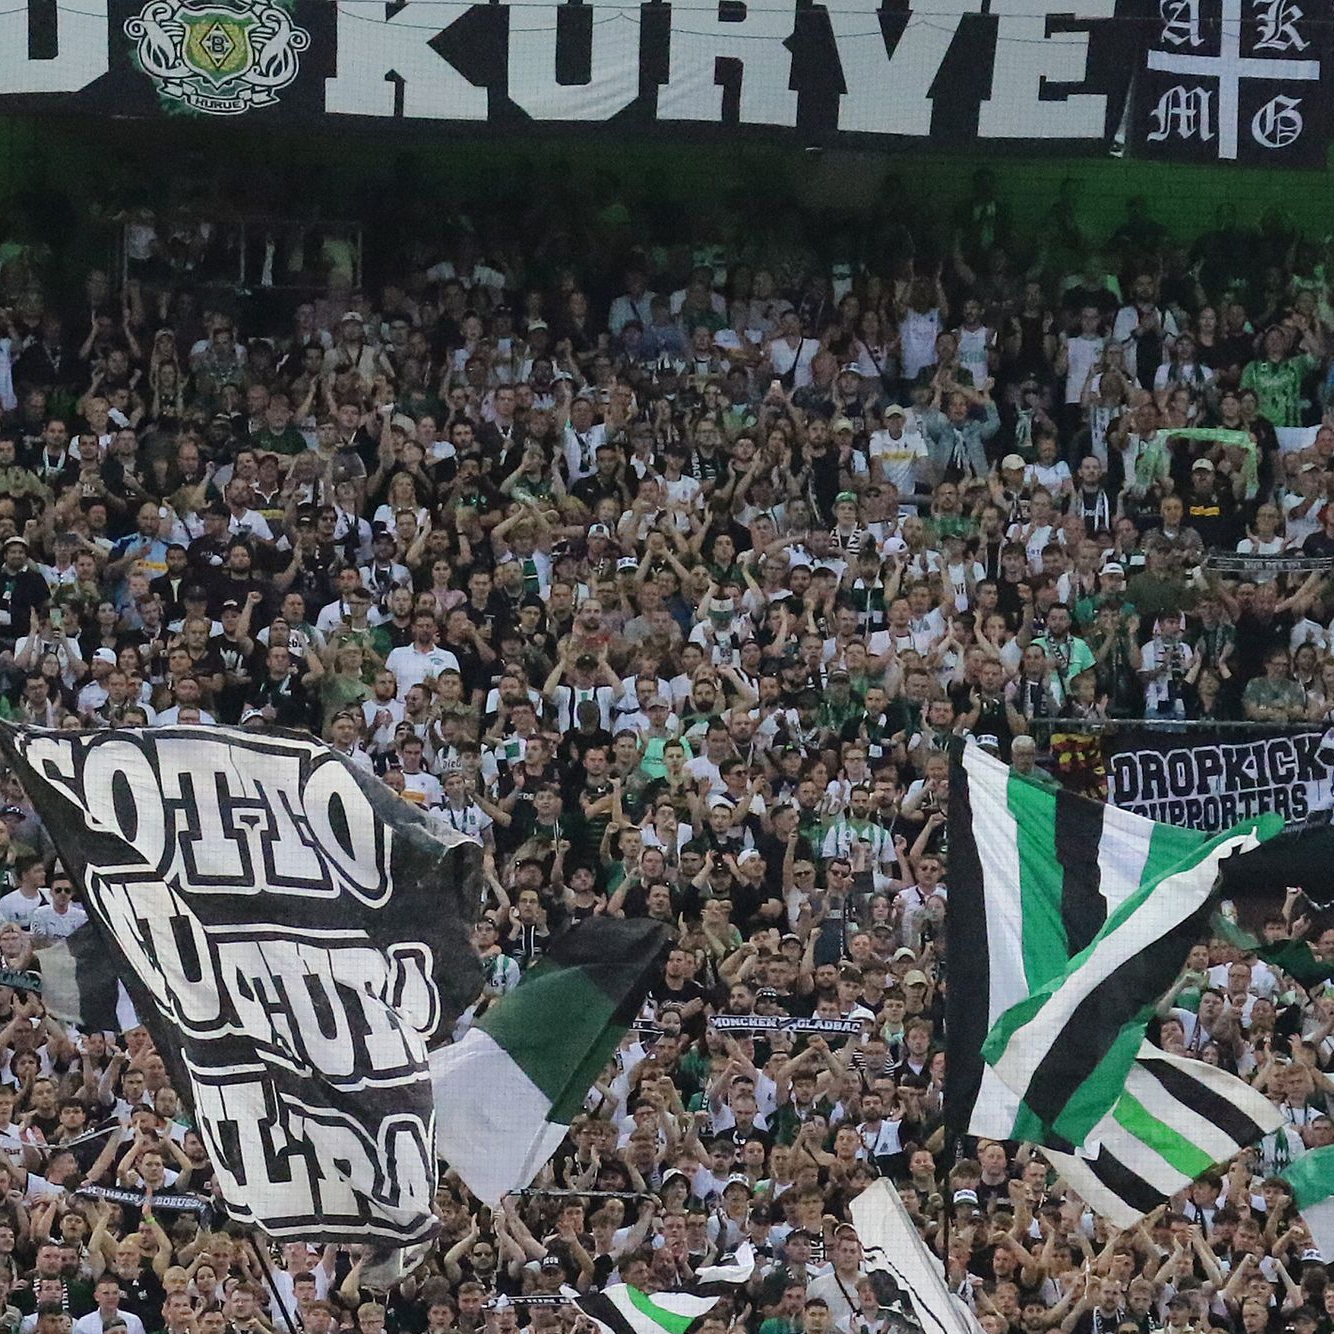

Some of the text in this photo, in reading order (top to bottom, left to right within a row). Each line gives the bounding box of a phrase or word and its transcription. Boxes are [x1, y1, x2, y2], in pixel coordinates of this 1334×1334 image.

[323, 0, 1108, 138] KURVE
[1148, 86, 1304, 148] M G
[24, 735, 395, 905] SOTTO
[1111, 733, 1328, 803] DROPKICK
